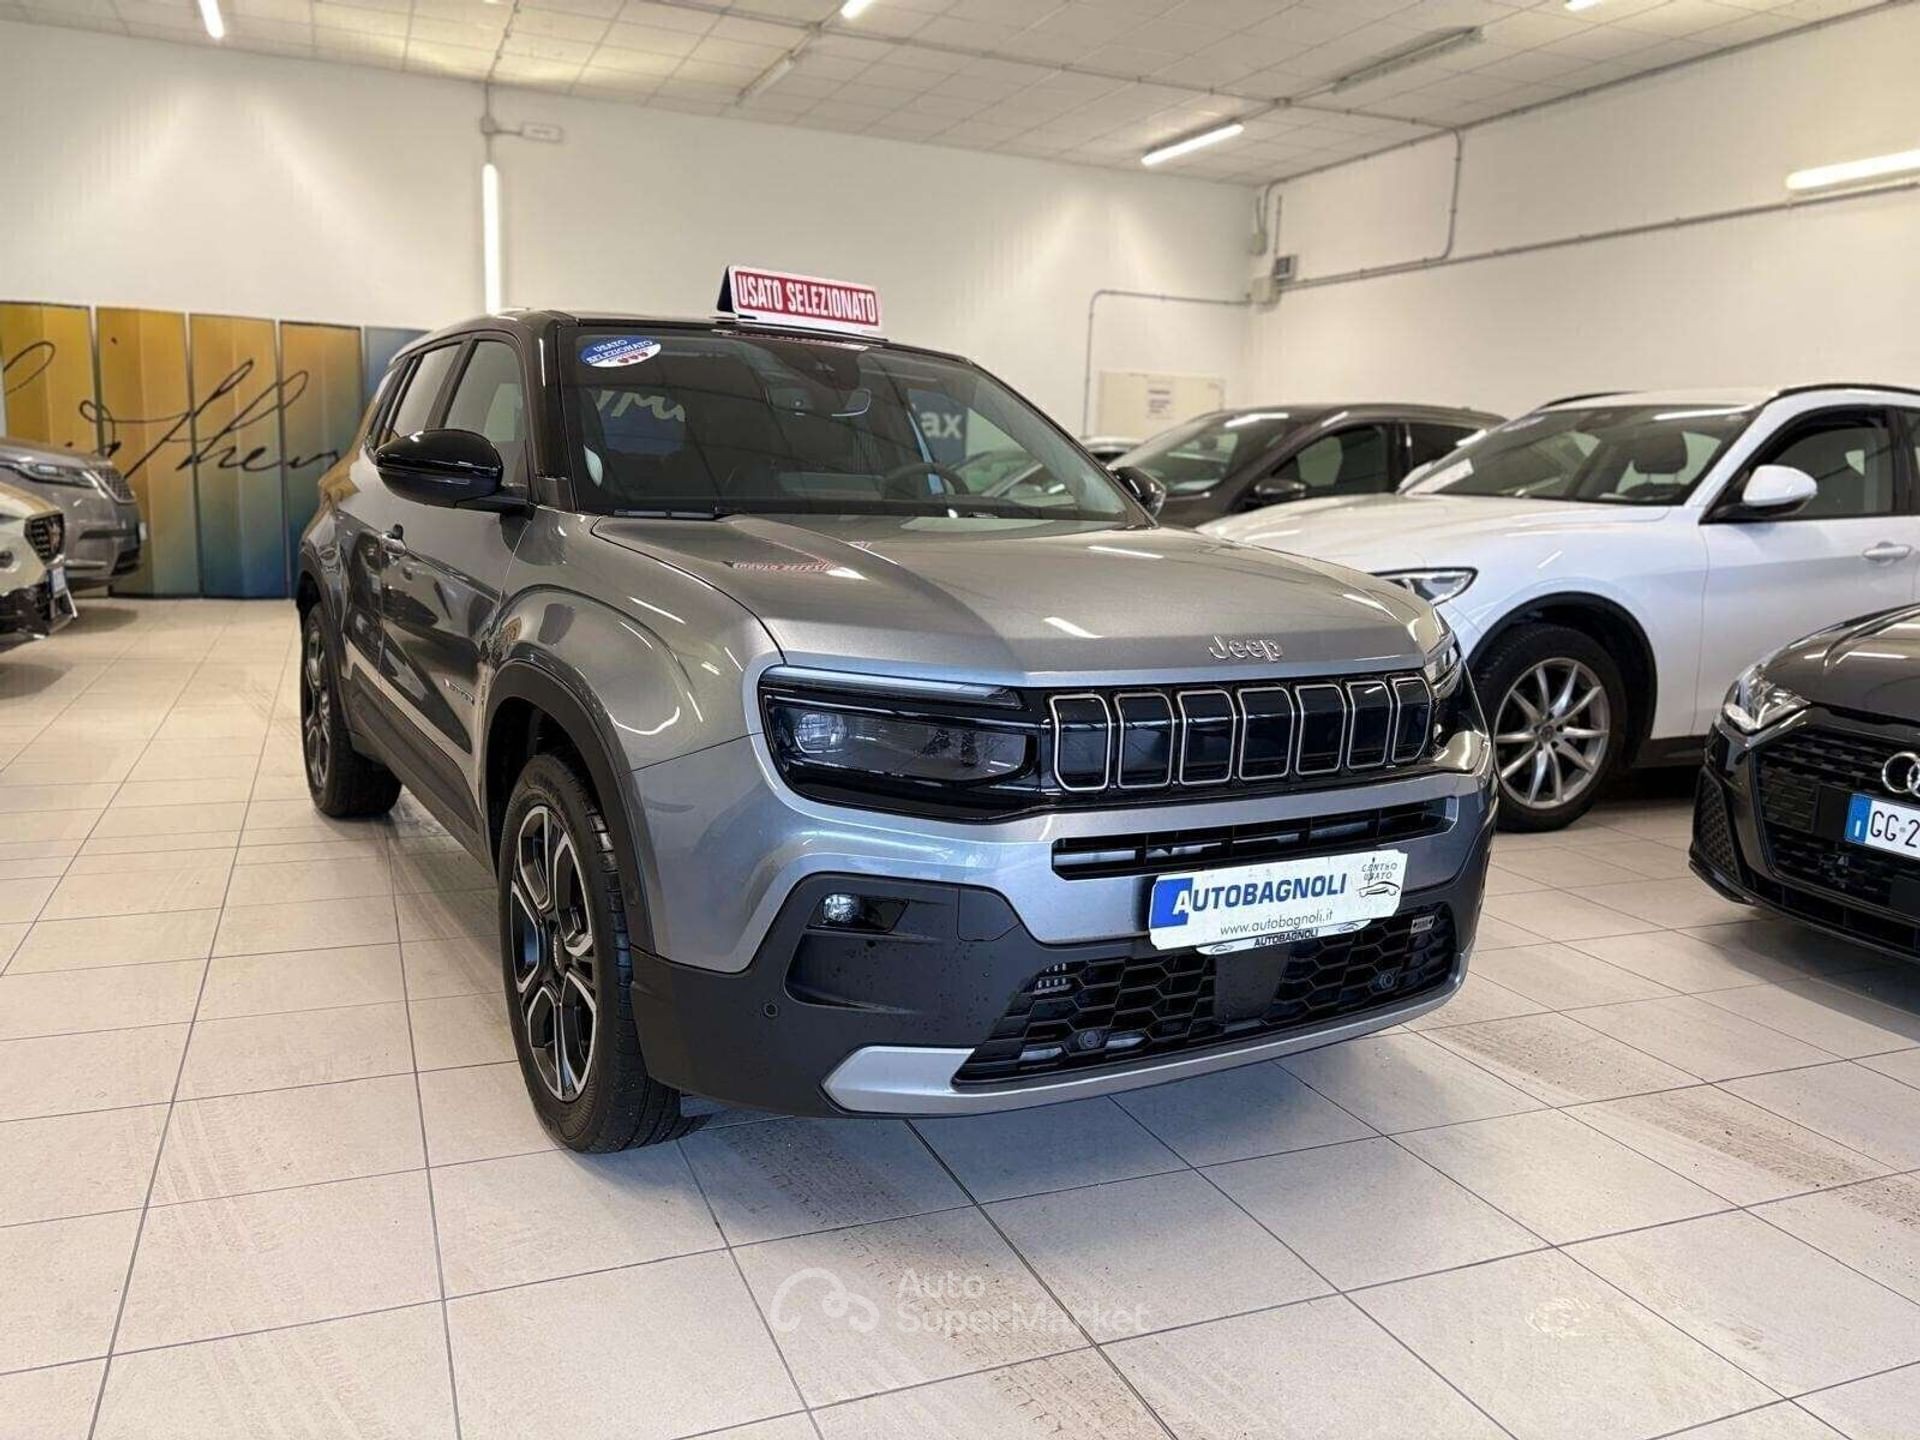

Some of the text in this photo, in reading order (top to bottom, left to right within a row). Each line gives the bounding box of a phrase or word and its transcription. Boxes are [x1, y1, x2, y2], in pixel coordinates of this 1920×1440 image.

[737, 274, 877, 323] USATO SELEZIONATO
[586, 340, 653, 363] SELEZIONATO
[593, 339, 628, 352] USATO
[1208, 634, 1282, 662] Jeep
[1172, 873, 1348, 916] AUTOBAGNOLI
[1220, 909, 1334, 936] www.autobagnoli.it
[1254, 928, 1320, 948] AUTOBAGNOLI
